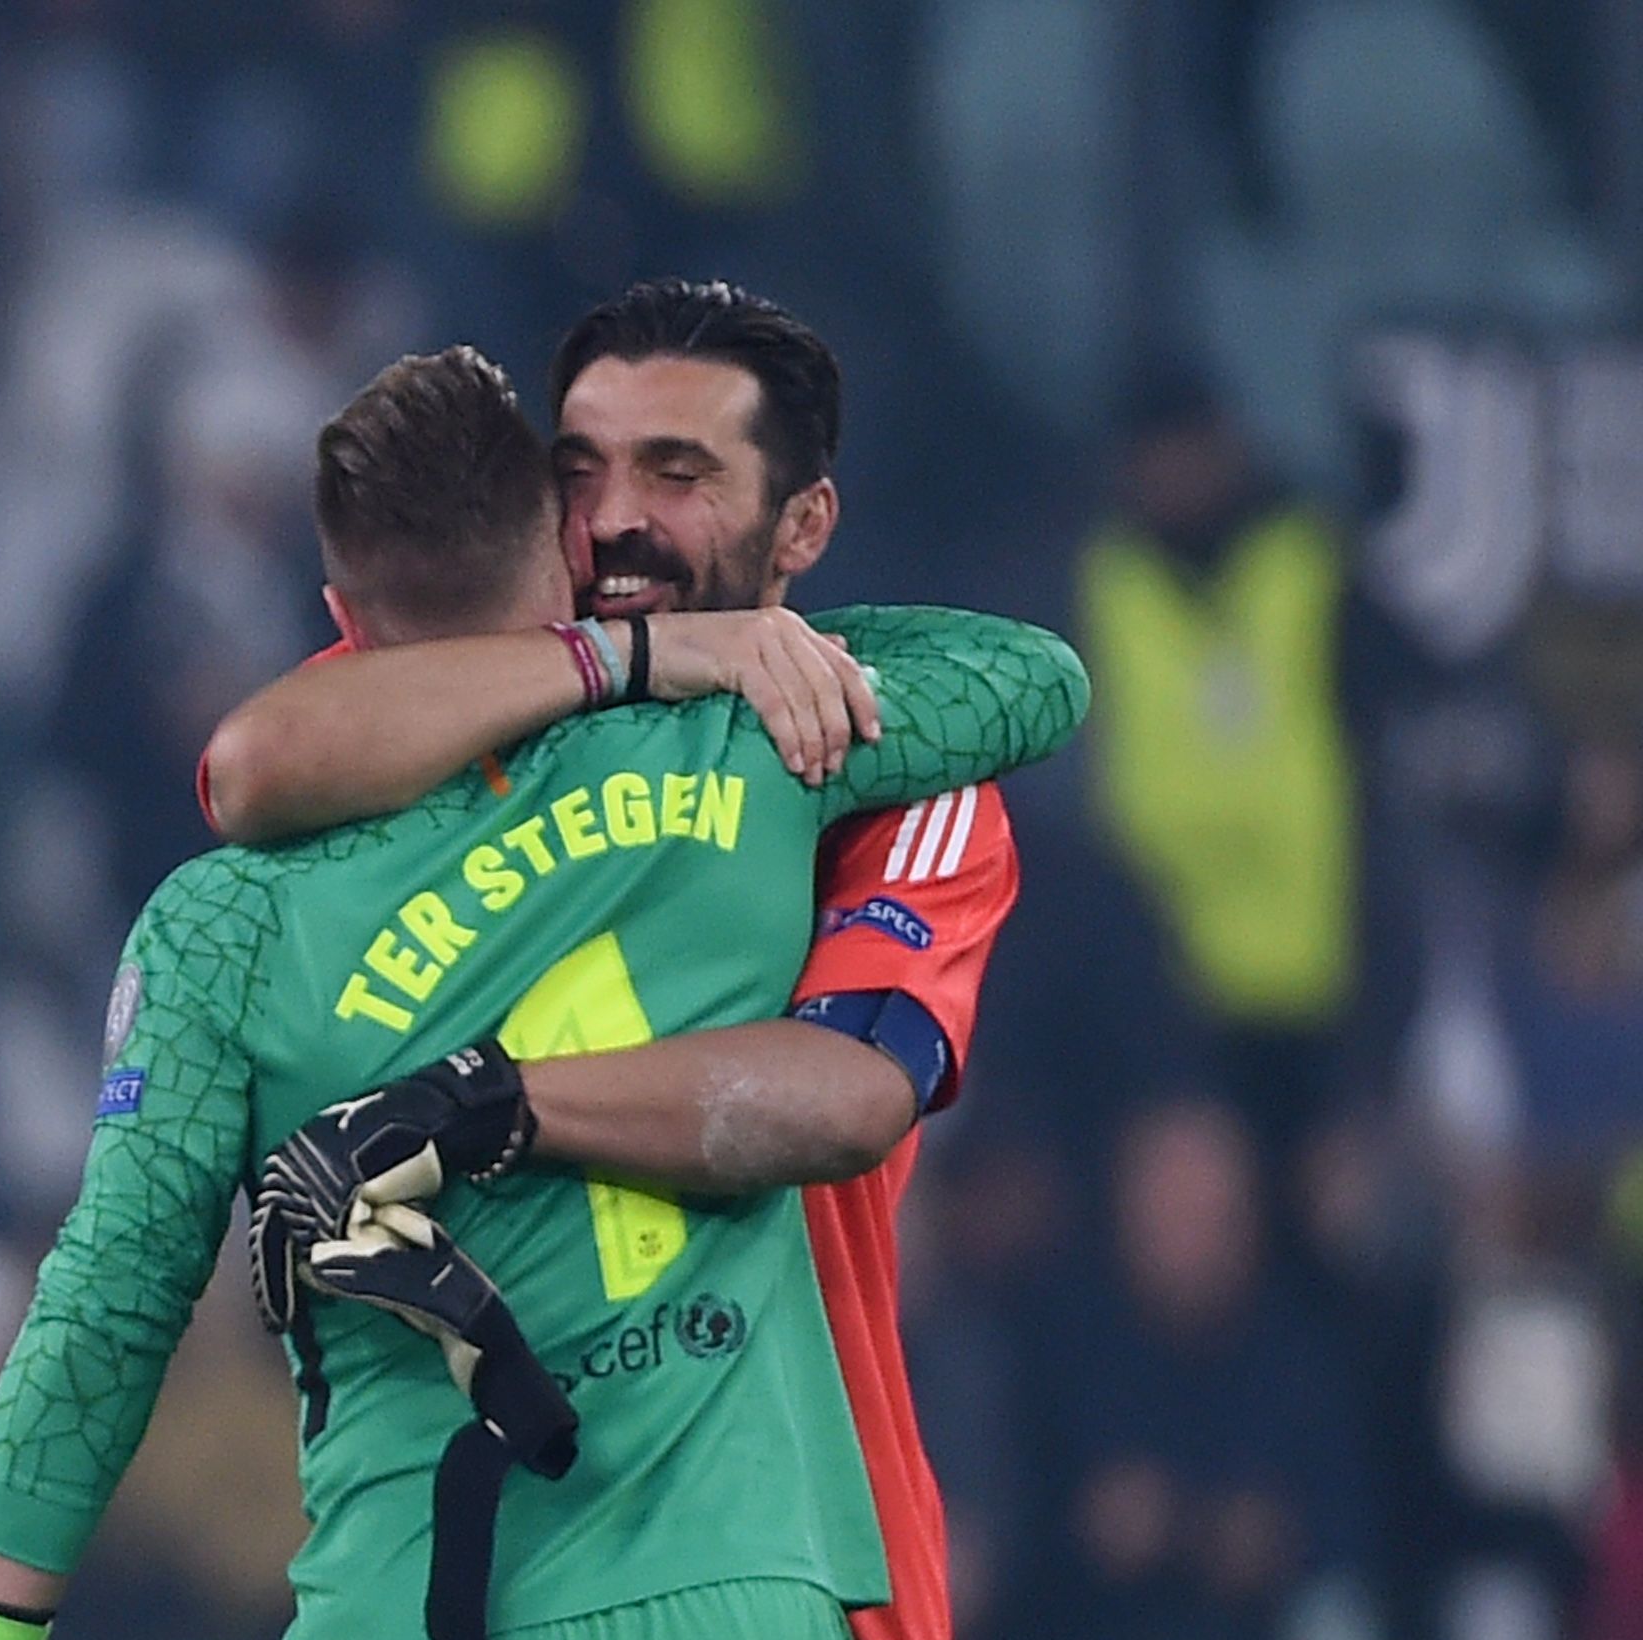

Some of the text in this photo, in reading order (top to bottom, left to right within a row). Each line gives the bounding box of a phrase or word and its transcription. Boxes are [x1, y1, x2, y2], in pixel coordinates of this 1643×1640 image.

[335, 769, 746, 1032] TER STEGEN
[843, 900, 932, 946] SPECT
